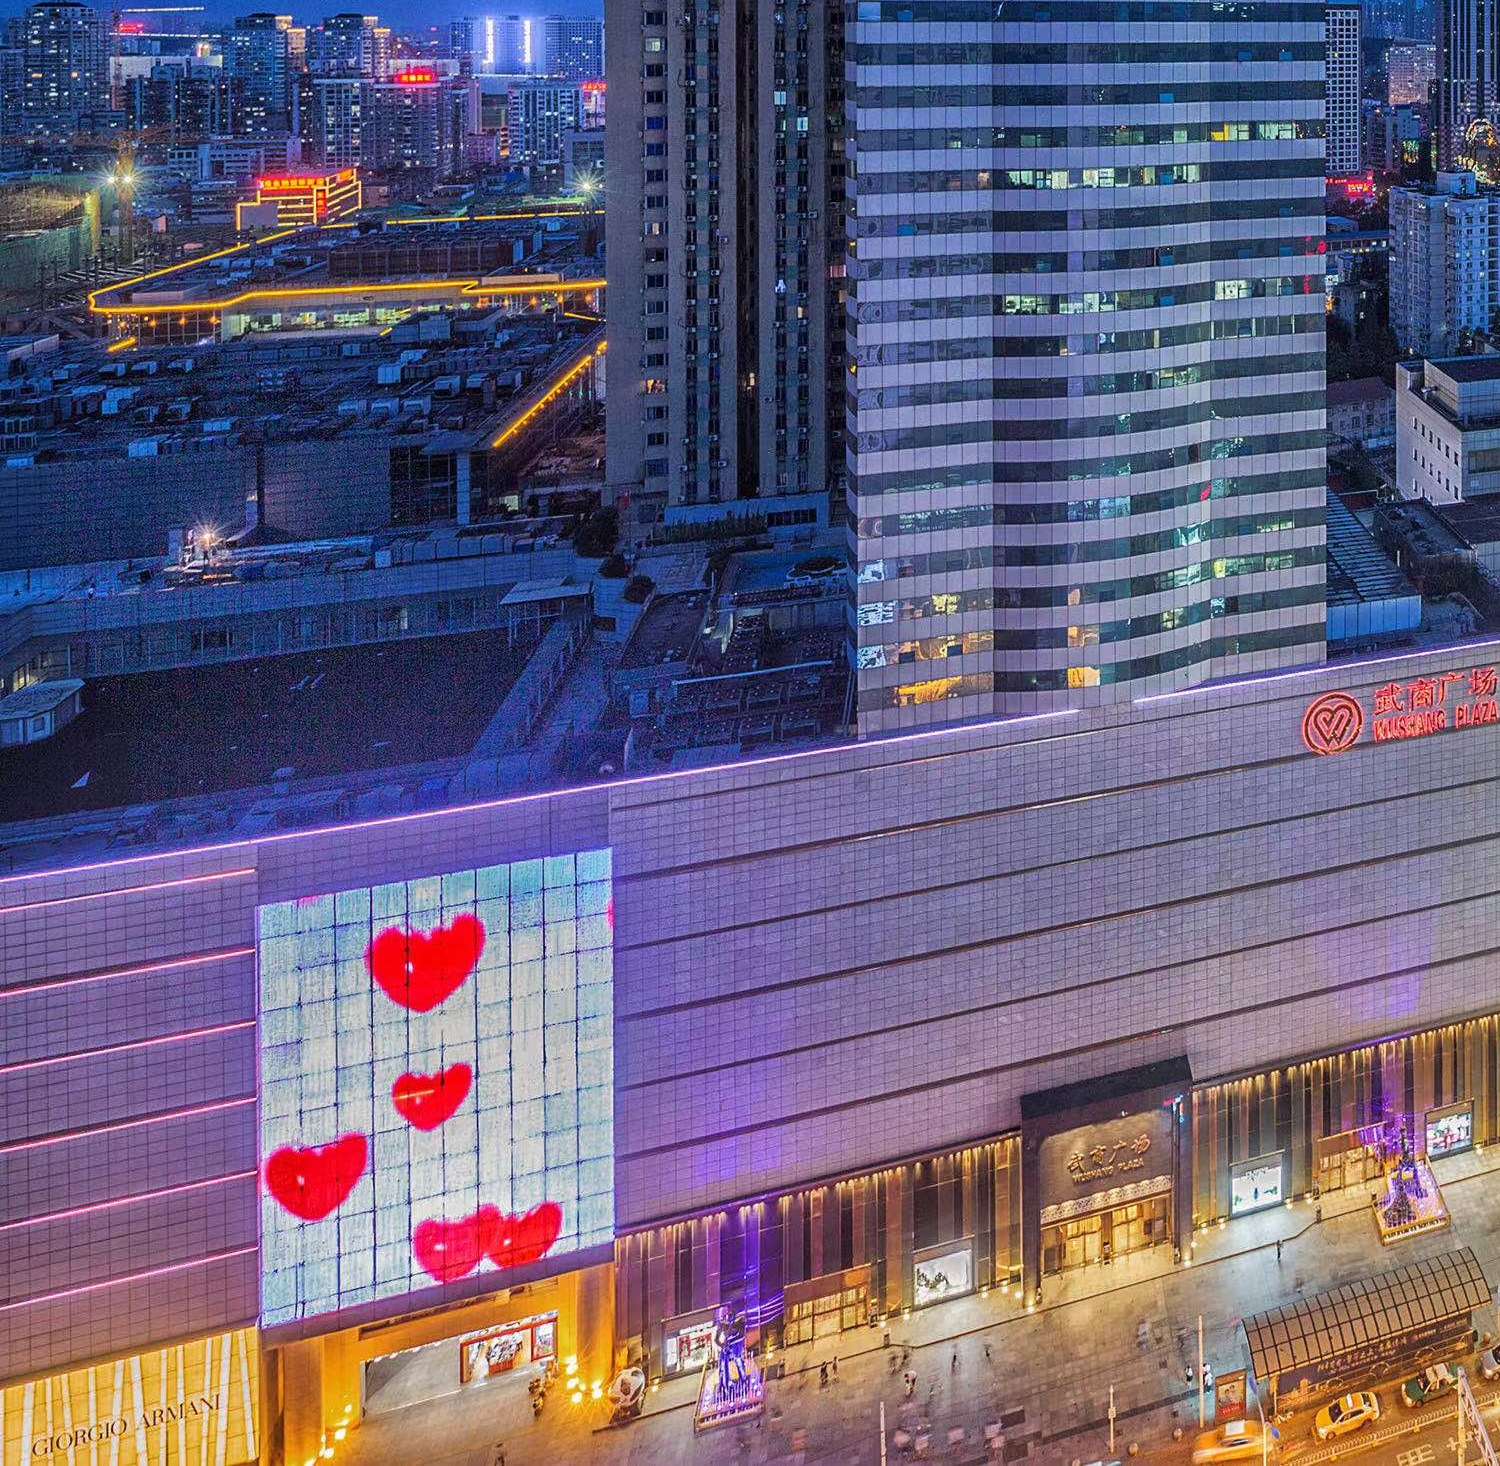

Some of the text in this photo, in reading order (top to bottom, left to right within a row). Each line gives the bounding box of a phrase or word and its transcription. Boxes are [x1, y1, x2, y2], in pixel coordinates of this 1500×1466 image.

[1372, 667, 1498, 716] 武商广场
[1373, 700, 1500, 743] WUSHANG PLAZA
[1066, 1134, 1151, 1173] 武商广场
[1117, 1158, 1145, 1172] PLAZA
[31, 1394, 222, 1457] GIORGIO ARMANI
